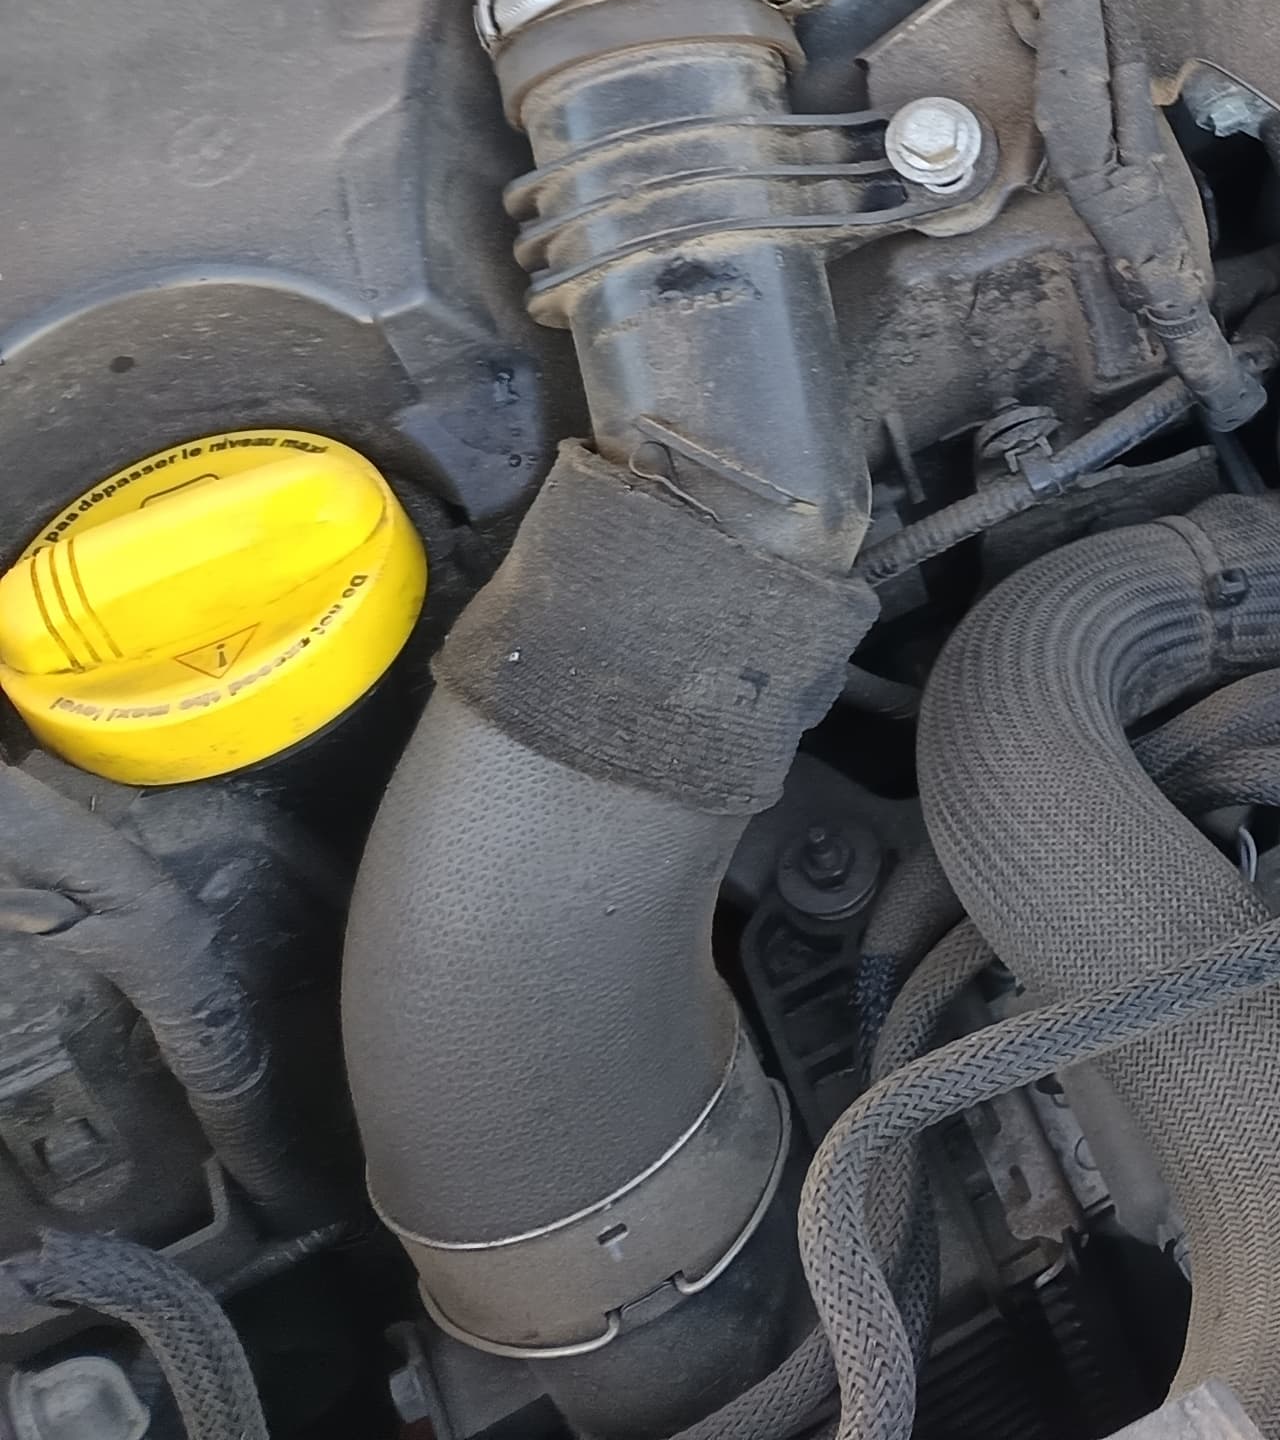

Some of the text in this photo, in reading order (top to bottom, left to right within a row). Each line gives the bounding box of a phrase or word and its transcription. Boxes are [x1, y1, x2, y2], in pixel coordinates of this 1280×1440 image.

[45, 513, 79, 543] pas
[182, 448, 202, 460] le
[209, 437, 277, 452] niveau
[280, 439, 328, 454] maxi
[49, 574, 369, 722] Do not exceed the maxi level
